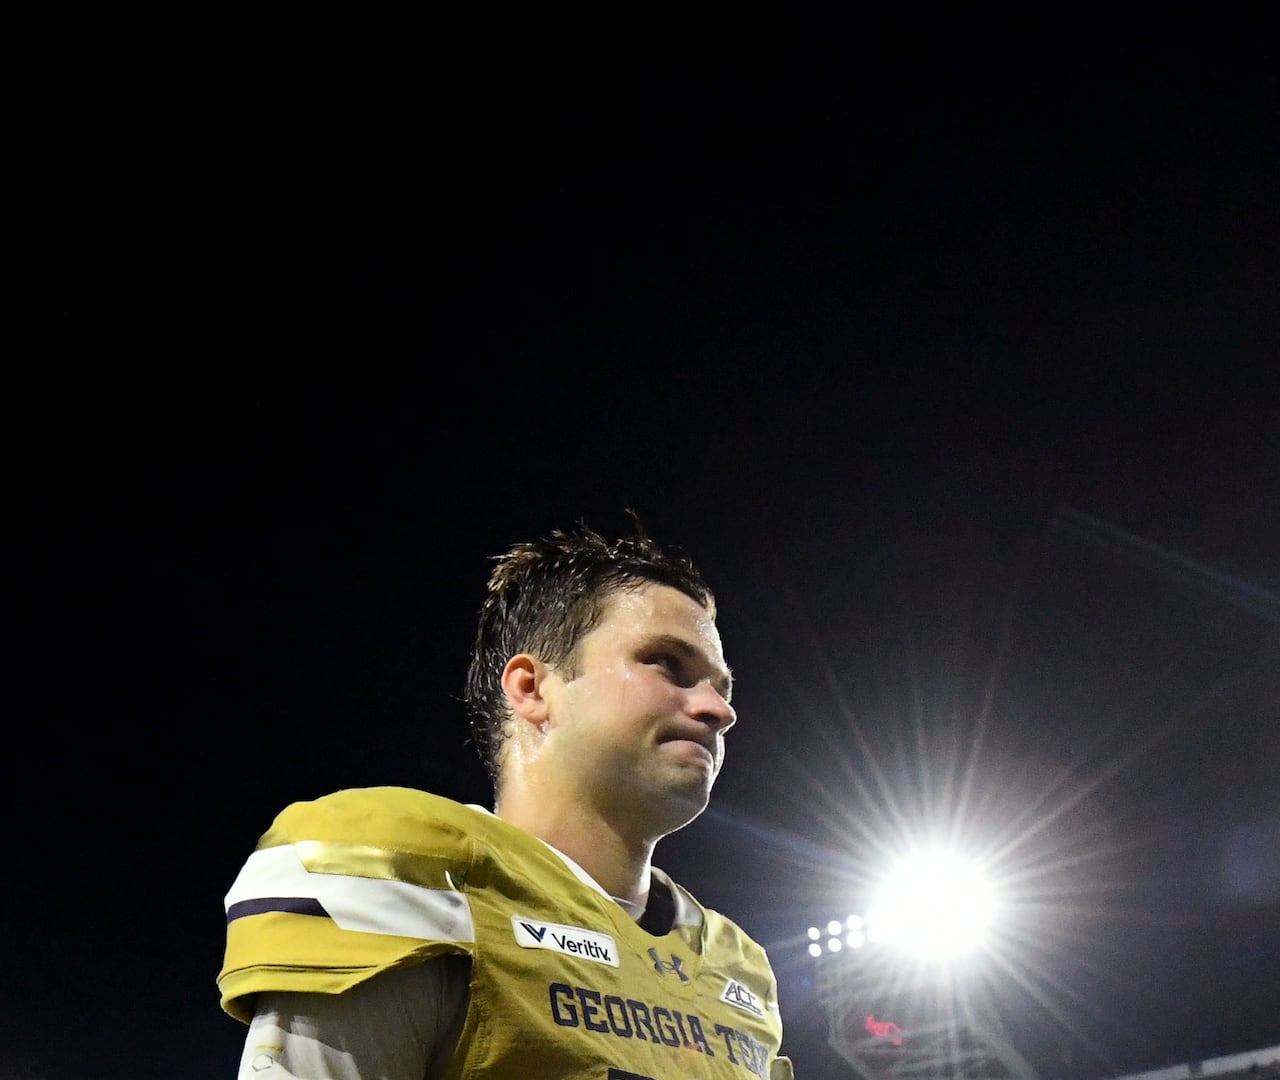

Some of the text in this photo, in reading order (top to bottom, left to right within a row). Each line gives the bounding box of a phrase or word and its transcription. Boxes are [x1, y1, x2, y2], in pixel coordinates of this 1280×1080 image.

[551, 933, 609, 961] Veritiv
[725, 982, 756, 1005] ACC
[549, 982, 714, 1056] GEORGIA
